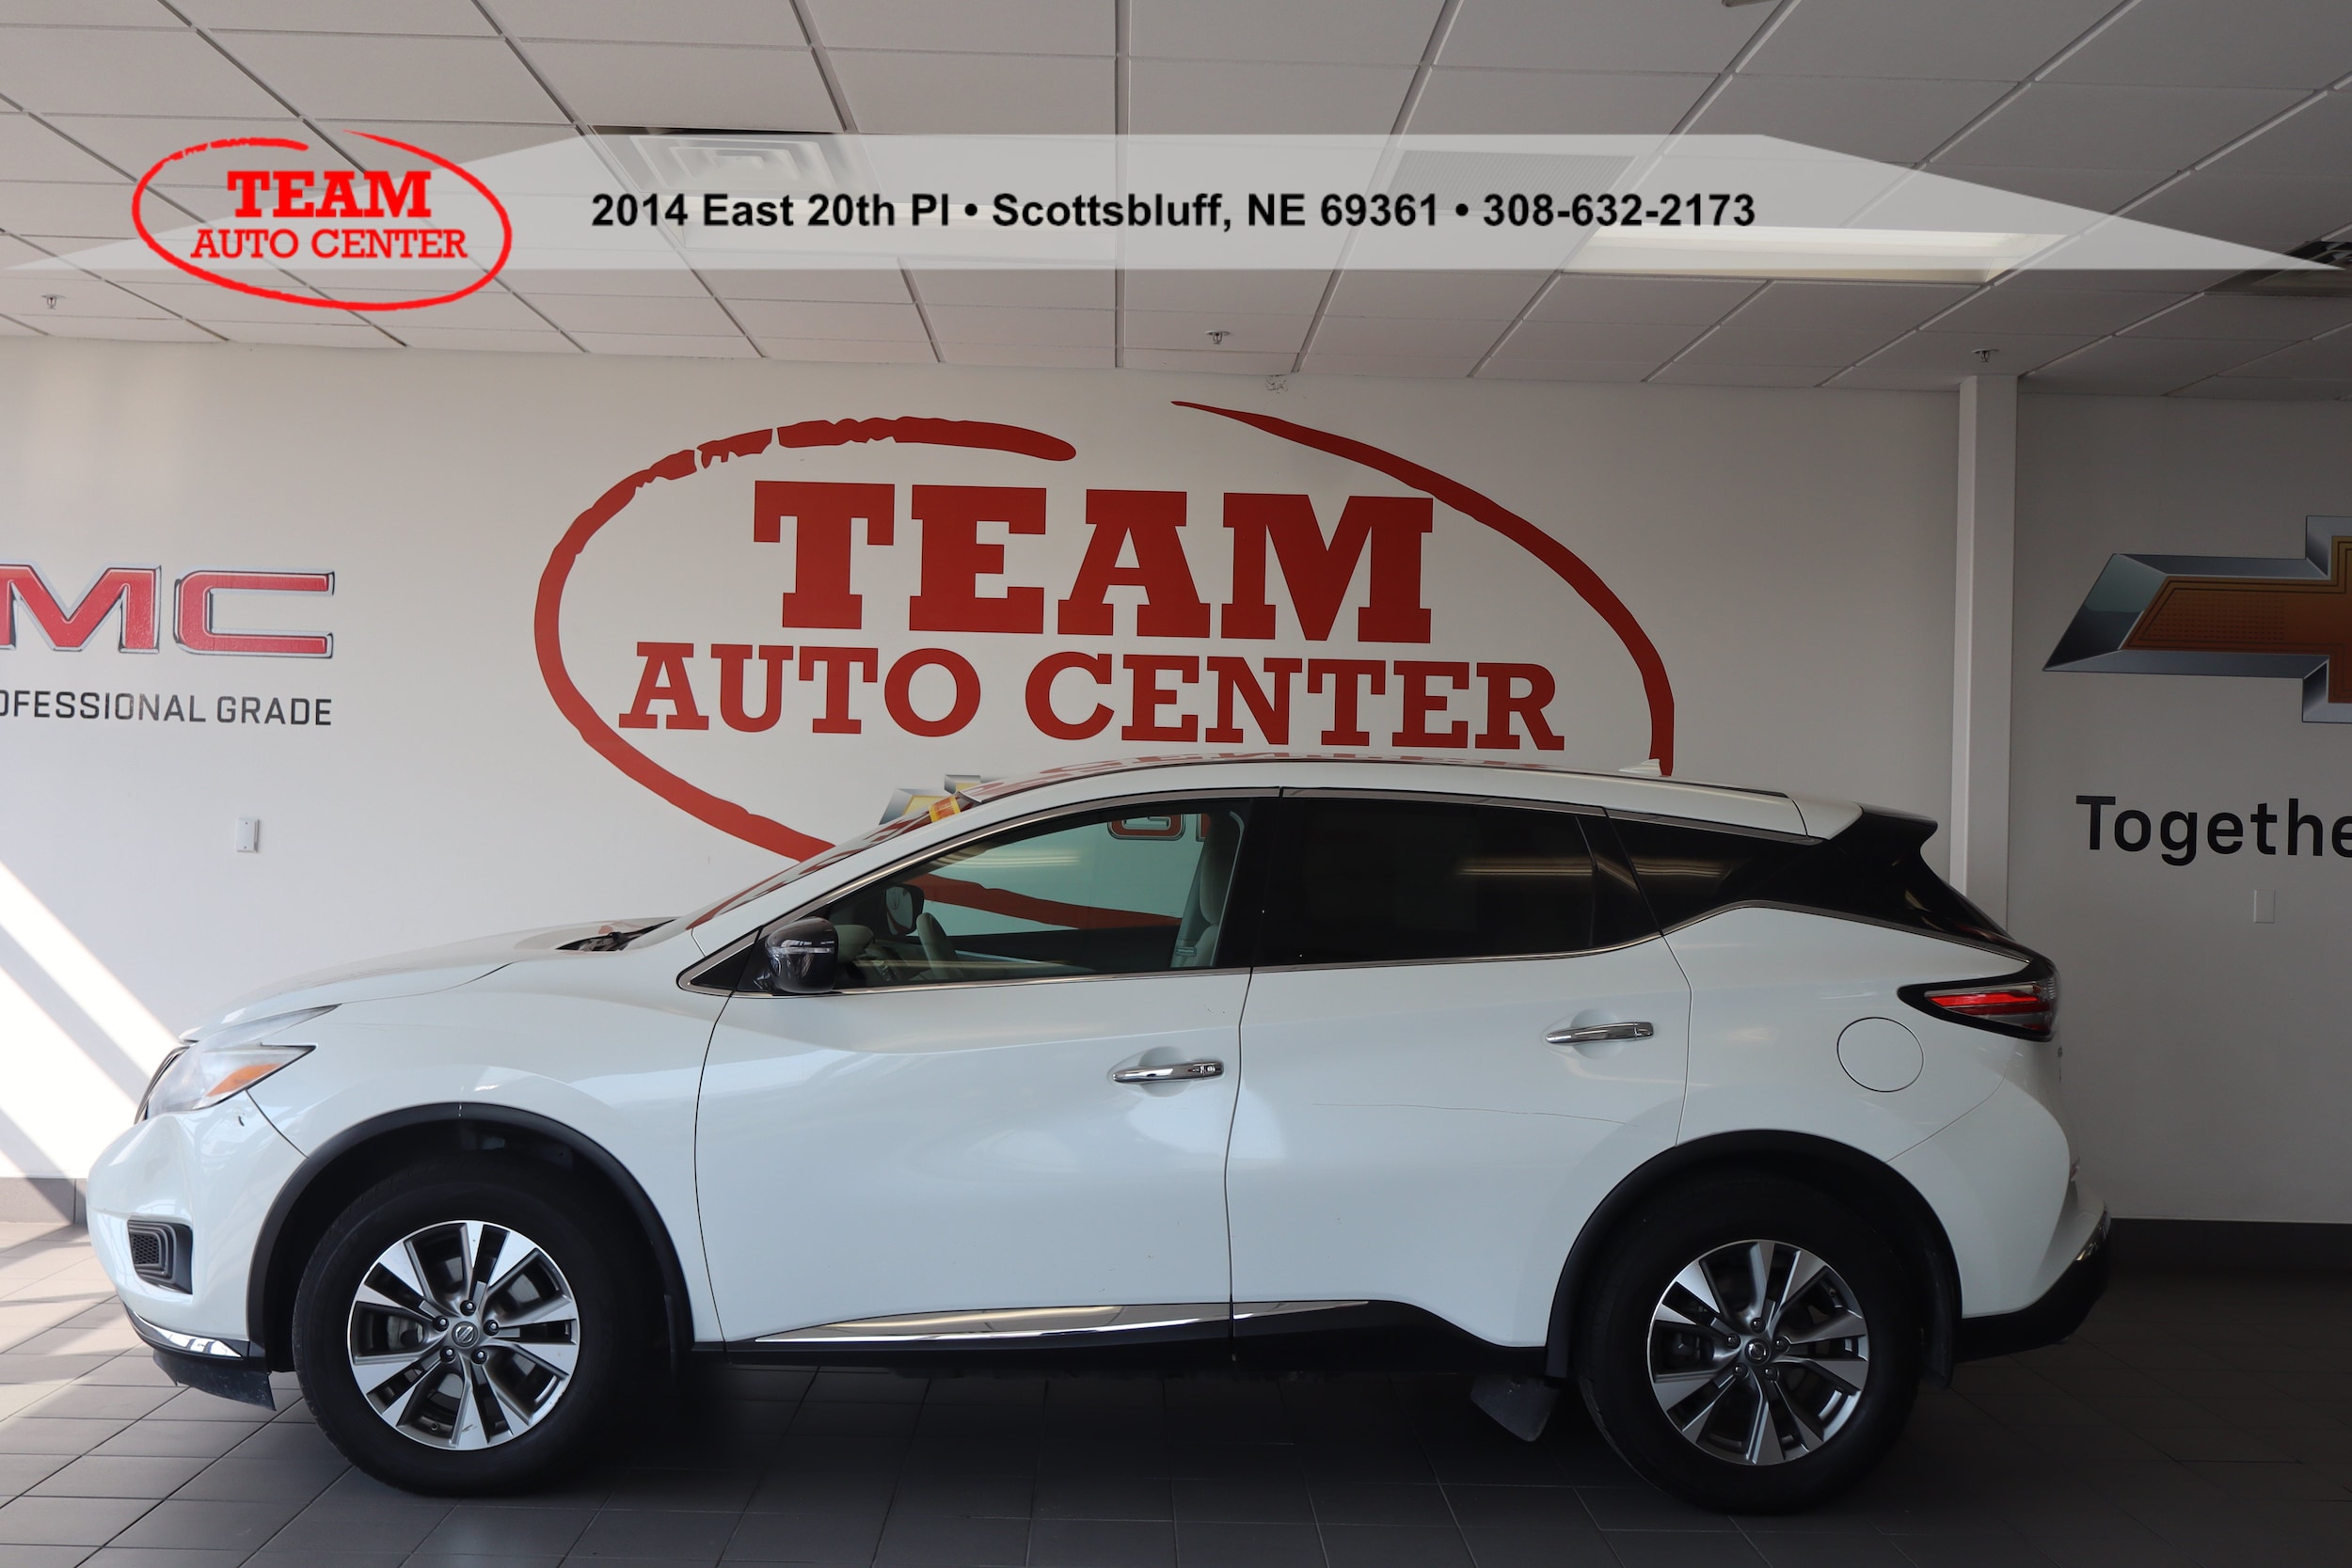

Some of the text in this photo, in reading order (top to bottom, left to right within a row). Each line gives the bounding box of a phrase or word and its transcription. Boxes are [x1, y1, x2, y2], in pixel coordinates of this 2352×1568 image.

[754, 480, 1433, 643] TEAM
[216, 696, 332, 726] GRADE
[618, 641, 1564, 751] AUTO CENTER
